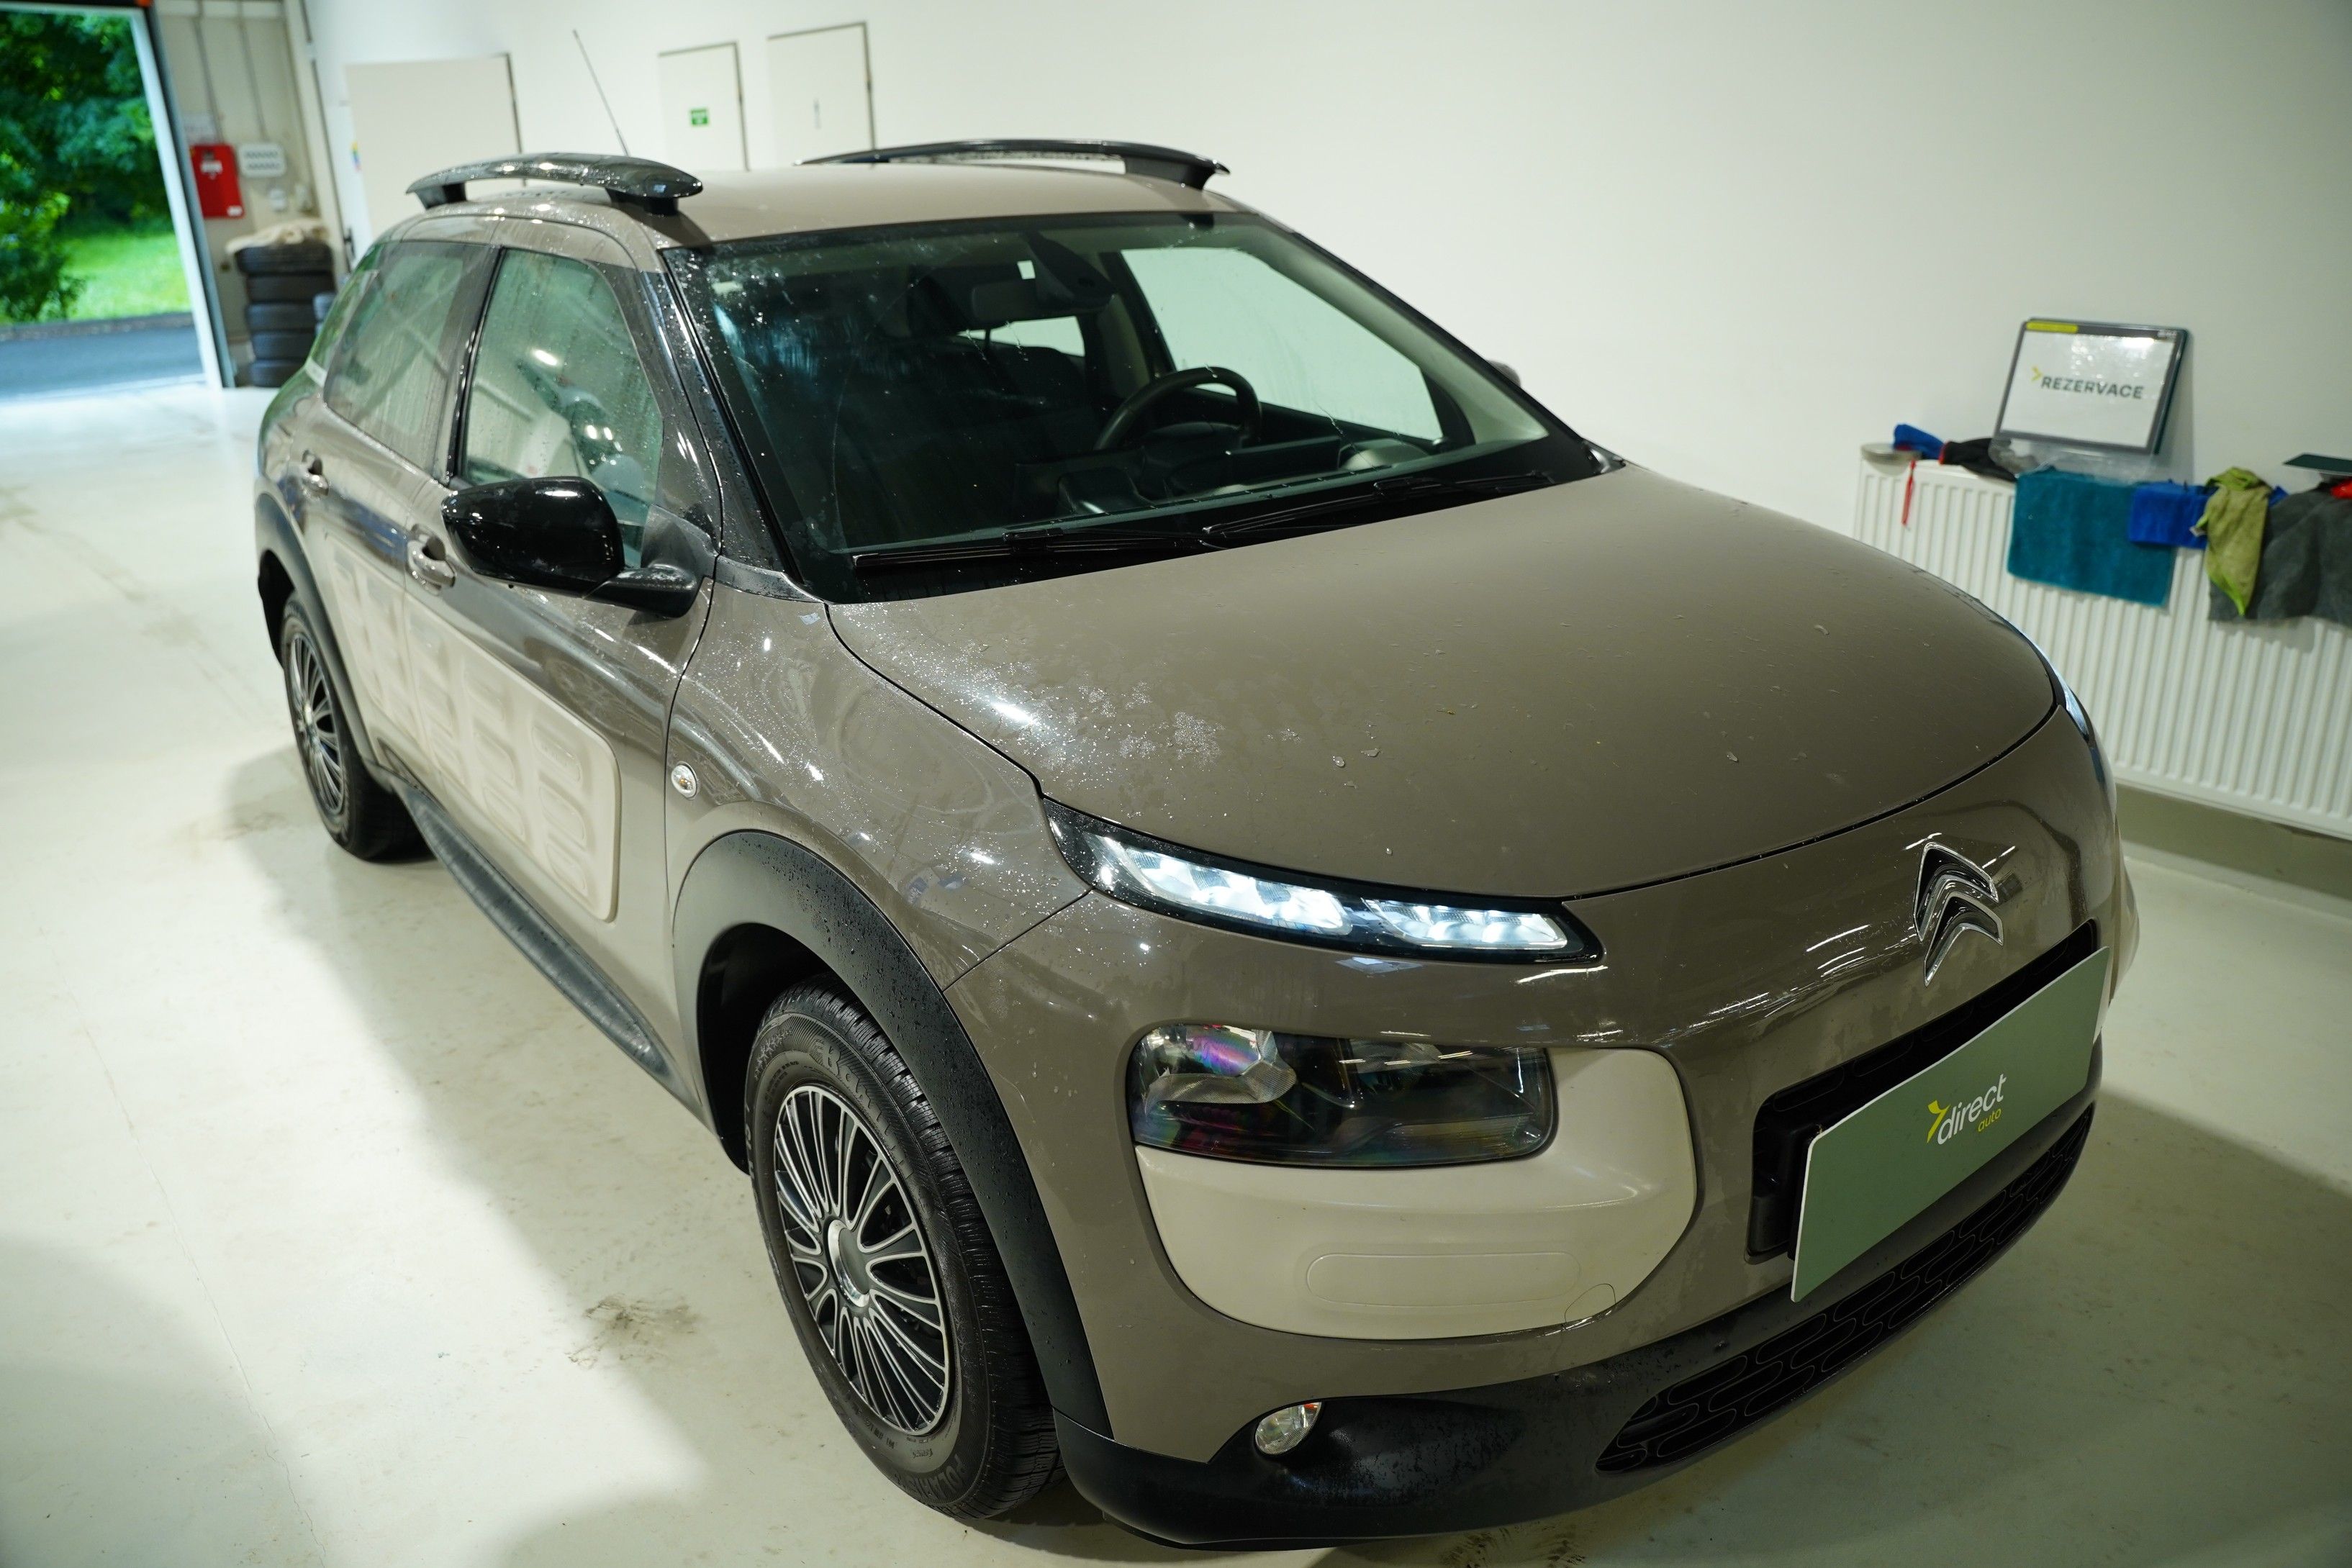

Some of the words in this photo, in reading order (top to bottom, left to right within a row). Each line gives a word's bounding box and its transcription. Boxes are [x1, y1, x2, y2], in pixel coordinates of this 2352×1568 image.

[2040, 376, 2145, 399] REZERVACE
[813, 1035, 914, 1180] Barum
[1937, 1073, 2007, 1145] direct
[1978, 1108, 2002, 1132] auto
